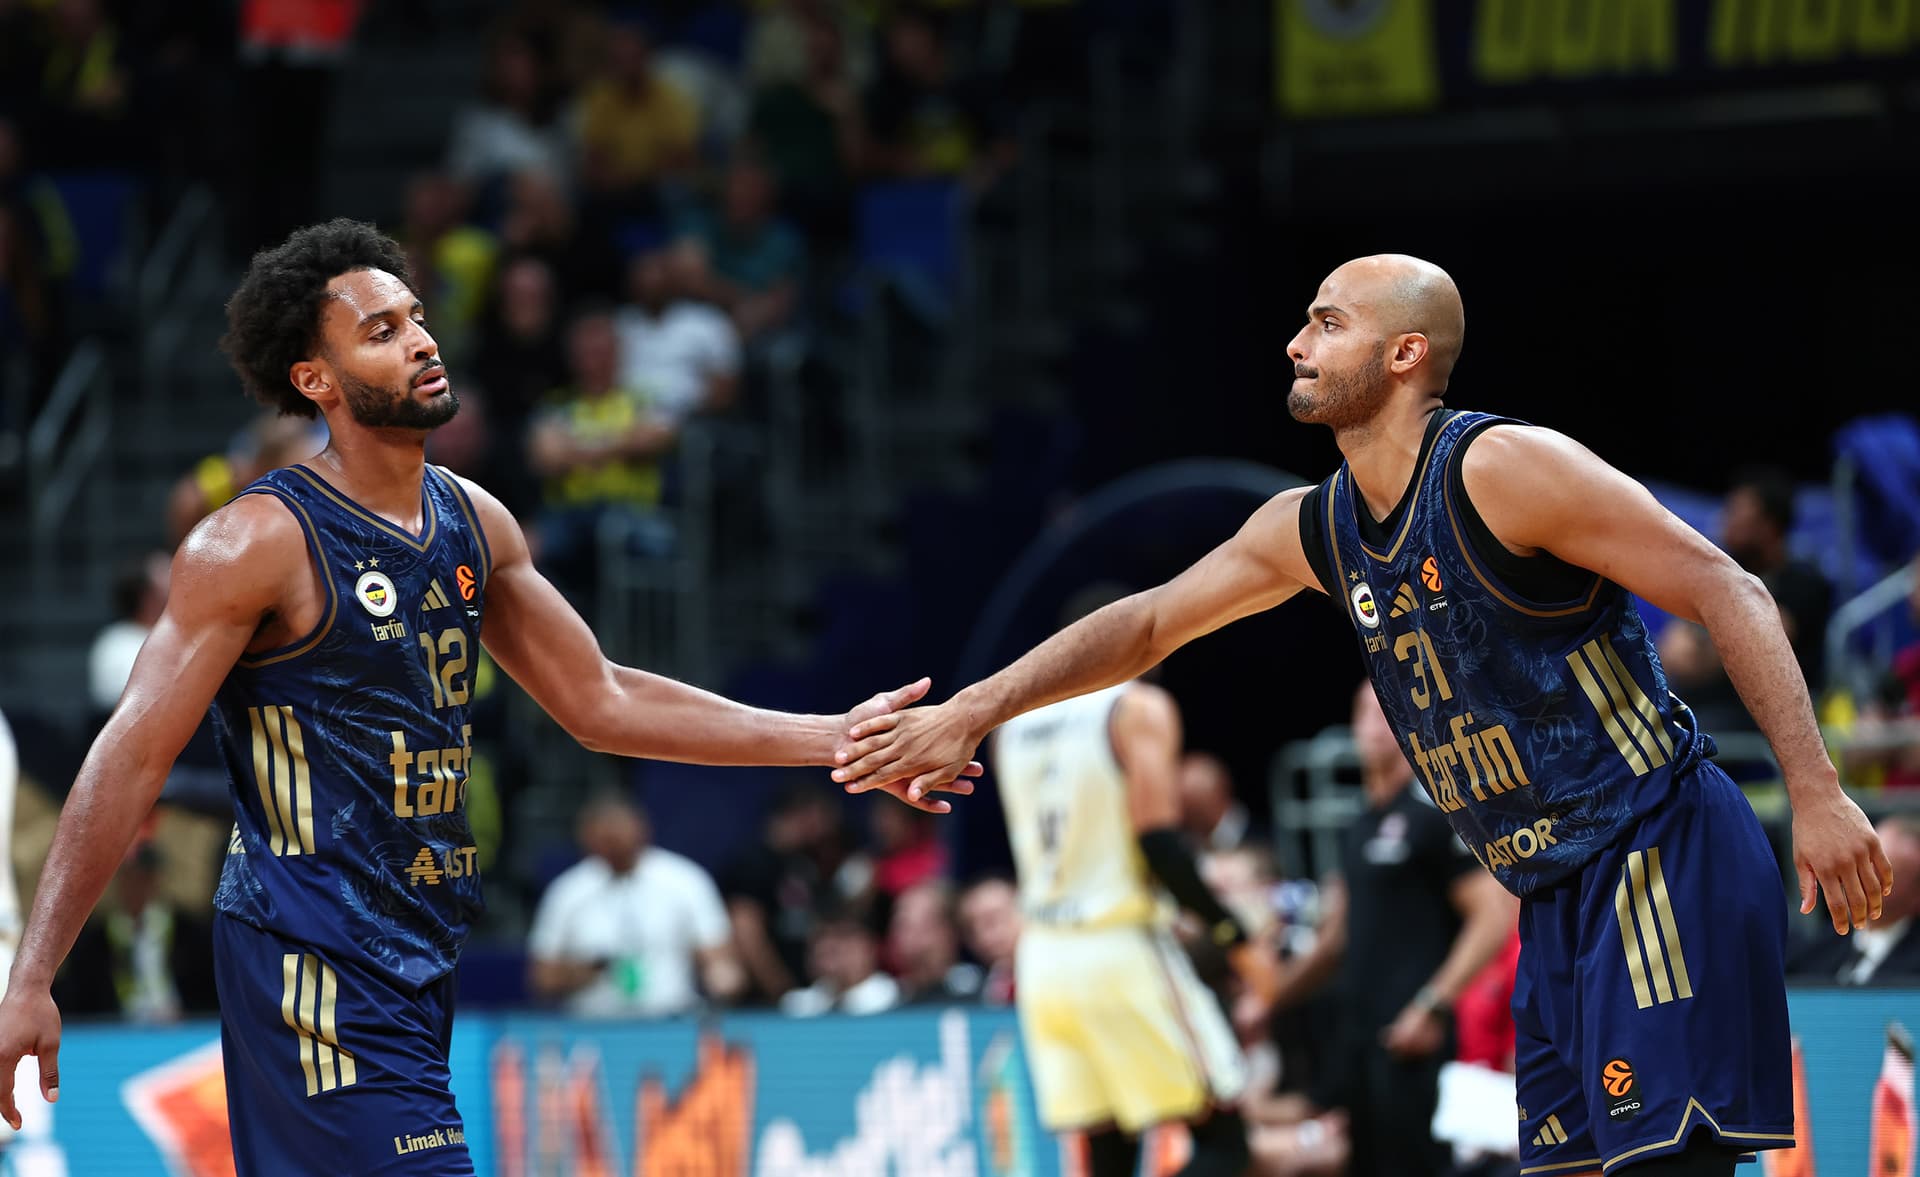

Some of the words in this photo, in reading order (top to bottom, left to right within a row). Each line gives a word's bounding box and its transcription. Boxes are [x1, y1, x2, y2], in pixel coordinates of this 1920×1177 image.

[370, 619, 406, 642] tarfin
[418, 627, 469, 709] 12
[1393, 626, 1454, 711] 31
[1408, 712, 1531, 814] tarfin
[444, 846, 481, 880] AST
[1610, 1102, 1640, 1116] ETIHAD
[394, 1129, 446, 1155] Limak
